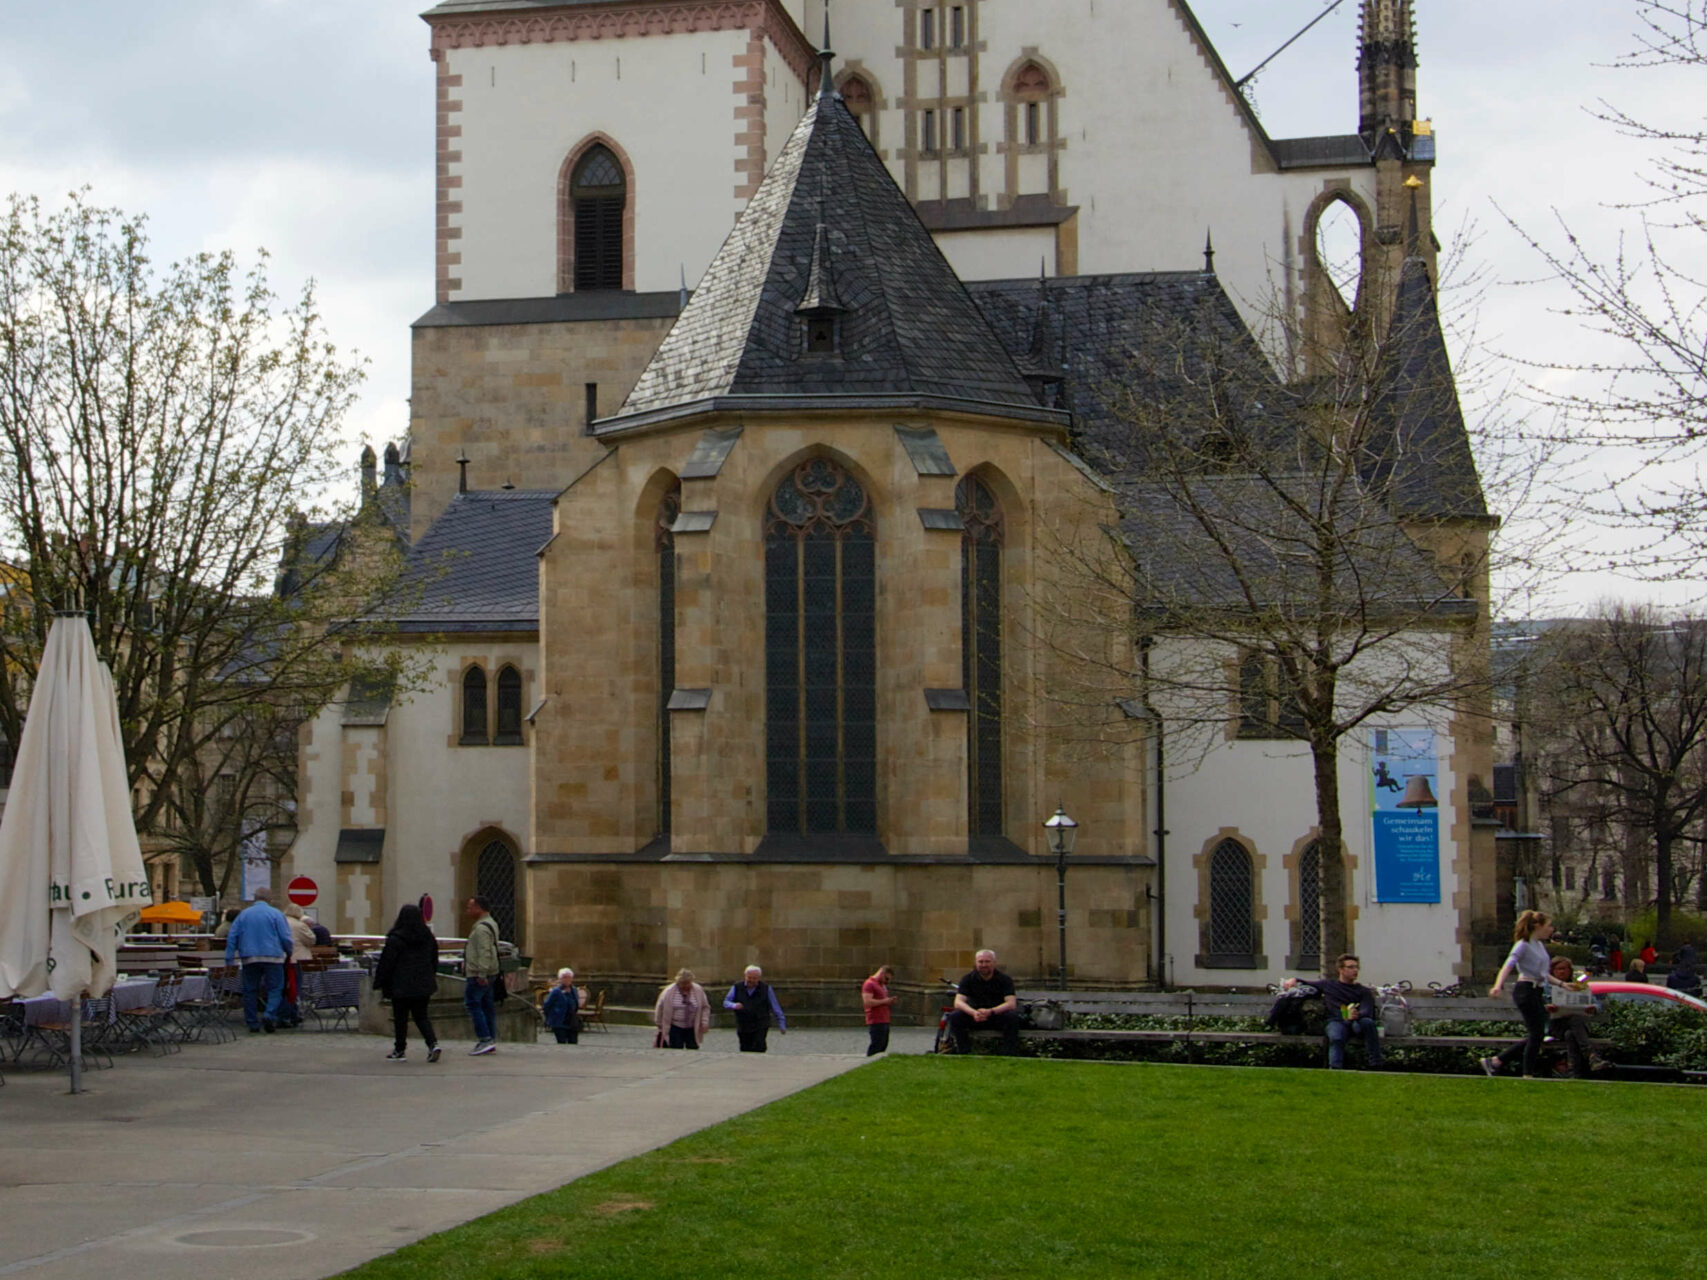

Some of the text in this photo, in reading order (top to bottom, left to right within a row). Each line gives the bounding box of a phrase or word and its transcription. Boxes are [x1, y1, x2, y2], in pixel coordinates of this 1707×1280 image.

[1383, 817, 1433, 825] Gemeinsam
[1398, 834, 1433, 842] wir das!
